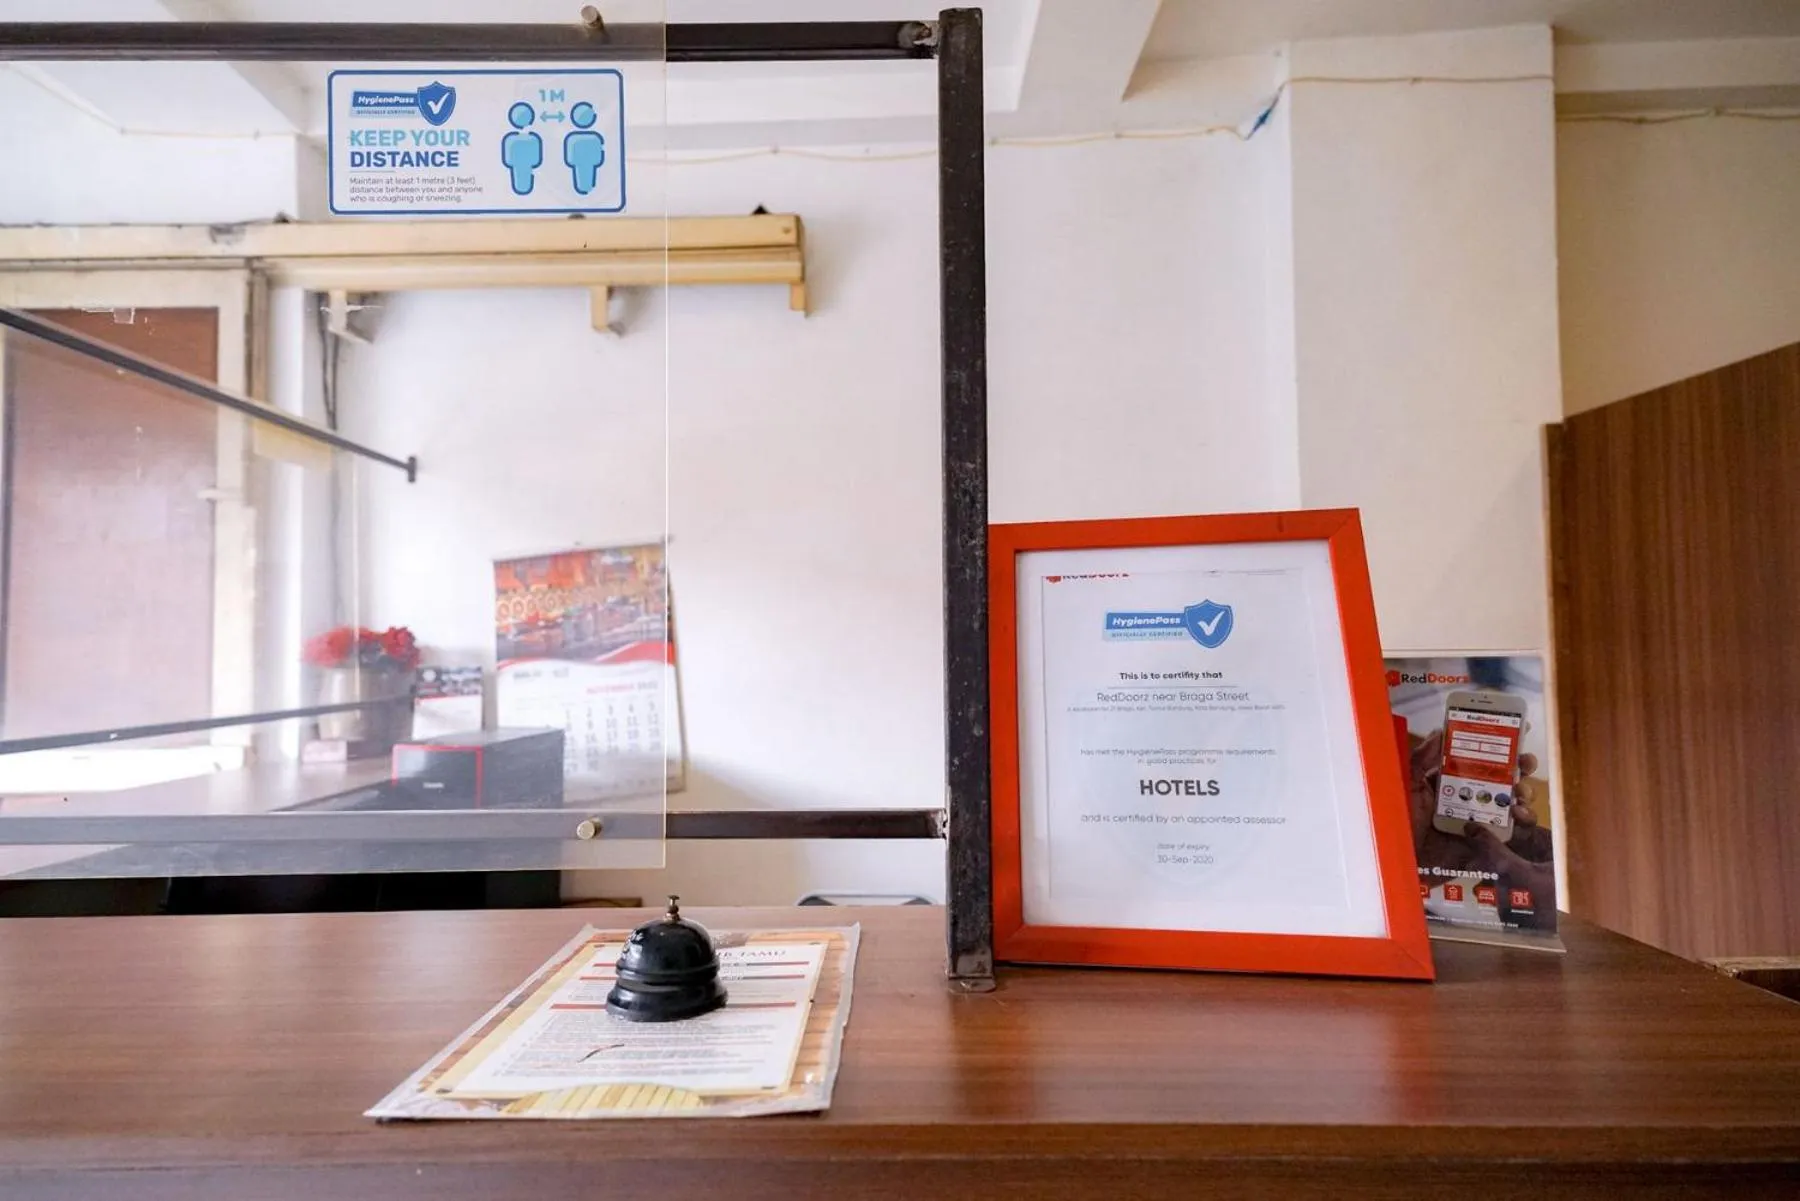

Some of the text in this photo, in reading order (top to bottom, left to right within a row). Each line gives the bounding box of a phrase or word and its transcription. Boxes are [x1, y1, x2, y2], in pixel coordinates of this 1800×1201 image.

[358, 95, 415, 105] HygienePass
[349, 129, 470, 146] KEEP YOUR
[350, 151, 460, 168] DISTANCE
[350, 176, 384, 185] Maintain
[385, 176, 393, 185] at
[395, 176, 414, 185] least
[422, 176, 445, 185] metre
[457, 176, 476, 185] feet)
[350, 185, 483, 195] distance between you and anyone
[350, 194, 366, 203] who
[368, 194, 376, 203] is
[377, 194, 414, 204] coughing
[416, 195, 424, 203] or
[1112, 616, 1181, 628] HygienePass
[1119, 672, 1139, 680] This
[1140, 672, 1148, 680] is
[1151, 672, 1160, 680] to
[1201, 671, 1223, 679] that
[1401, 673, 1469, 684] RedDoorz
[1097, 691, 1250, 703] RedDoorz near Braga Street
[1140, 779, 1220, 796] HOTELS
[1081, 814, 1101, 823] and
[1103, 814, 1110, 822] is
[1112, 814, 1153, 823] certified
[1156, 814, 1168, 824] by
[1170, 815, 1185, 823] an
[1187, 815, 1240, 825] appointed
[1157, 842, 1175, 850] date
[1187, 843, 1209, 852] expiry
[1157, 854, 1214, 864] 30-Sep-2020
[1432, 866, 1499, 880] Guarantee
